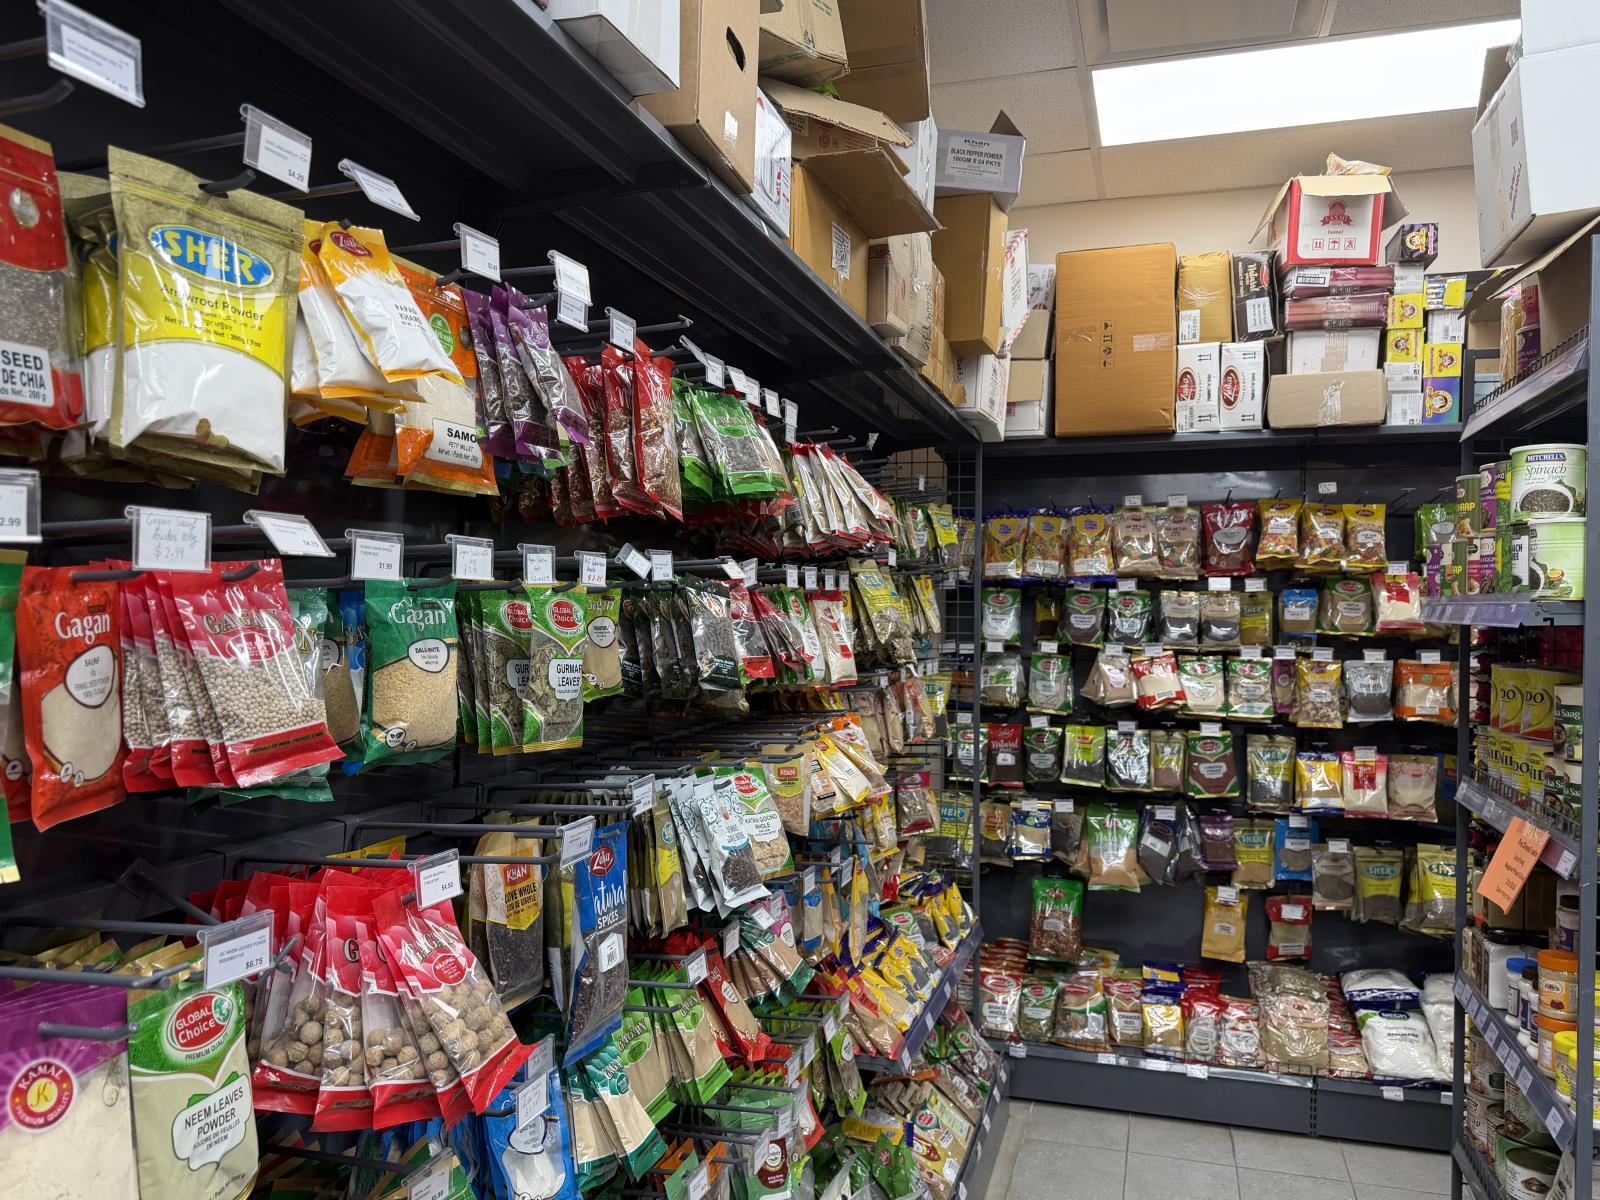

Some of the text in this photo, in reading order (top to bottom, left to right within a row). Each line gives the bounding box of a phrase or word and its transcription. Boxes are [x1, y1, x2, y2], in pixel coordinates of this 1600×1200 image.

[966, 149, 984, 158] PEPPER
[163, 230, 256, 282] SHER
[222, 300, 265, 321] Powder
[1, 349, 44, 371] SEED
[2, 368, 17, 386] DE
[19, 370, 47, 391] CHIA
[1221, 374, 1234, 402] Zaika
[1524, 463, 1567, 478] Spinach
[378, 562, 393, 570] $1.99
[389, 600, 447, 632] Gagan
[552, 606, 572, 615] GLOBAL
[553, 613, 574, 622] Choice
[54, 611, 112, 645] Gagan
[514, 663, 529, 674] GUR
[517, 677, 529, 687] LEA
[557, 677, 580, 687] LEAVES
[1524, 691, 1545, 704] DO
[1560, 709, 1581, 719] Saag
[941, 806, 961, 816] HER
[506, 863, 528, 882] KHAN
[517, 882, 537, 898] WHOLE
[594, 869, 627, 916] atural
[597, 909, 619, 929] SPICES
[245, 957, 263, 970] $6.75
[175, 1006, 212, 1031] GLOBAL
[178, 1018, 216, 1044] Choice
[184, 1032, 229, 1061] PREMIUM QUALITY
[17, 1063, 64, 1090] KAMAL
[30, 1080, 53, 1107] K
[15, 1090, 70, 1126] PREMIUM QUALITY
[184, 1086, 244, 1131] NEEM LEAVES
[197, 1107, 236, 1140] POWDER
[212, 1131, 219, 1139] DE
[220, 1118, 241, 1136] FEUILLES
[213, 1135, 229, 1147] NEEM
